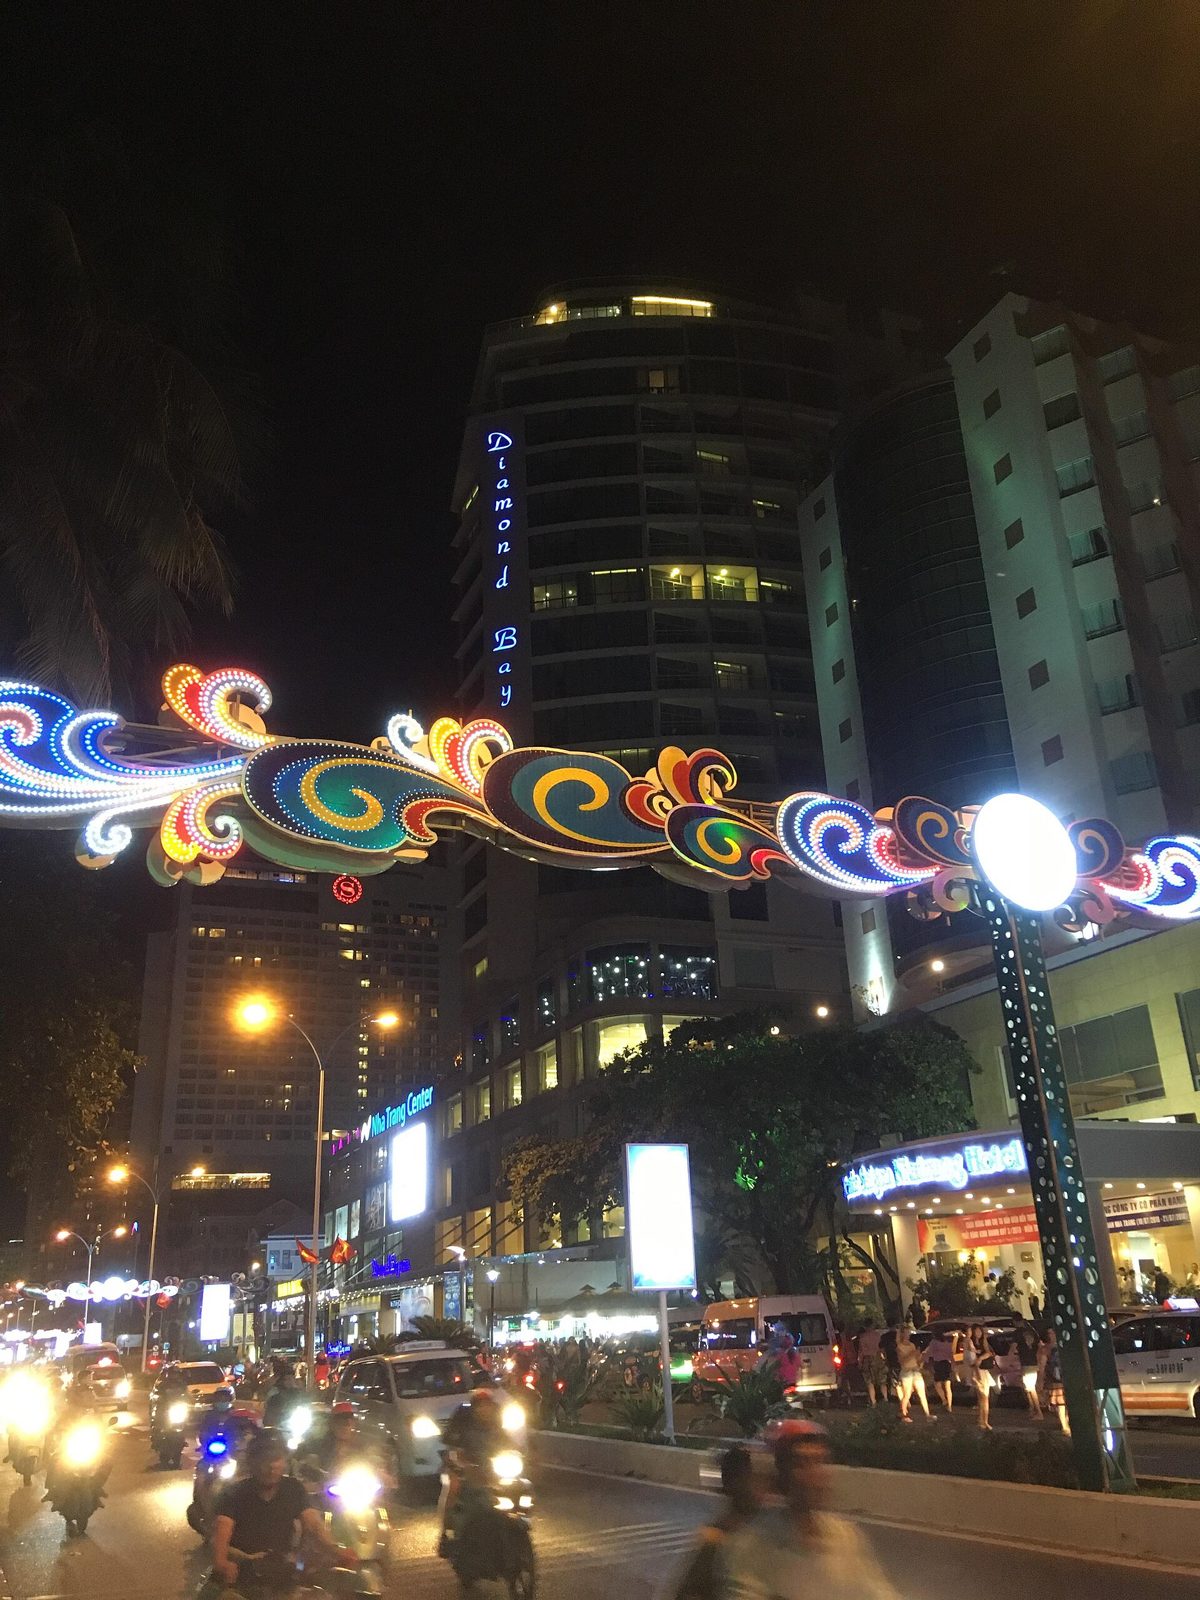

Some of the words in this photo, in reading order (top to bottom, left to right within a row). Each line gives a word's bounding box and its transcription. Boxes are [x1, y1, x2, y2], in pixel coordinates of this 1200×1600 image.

[487, 431, 512, 589] Diamond
[493, 627, 517, 706] Bay
[371, 1112, 386, 1138] Nha
[385, 1106, 406, 1128] Trang
[407, 1086, 433, 1117] Center
